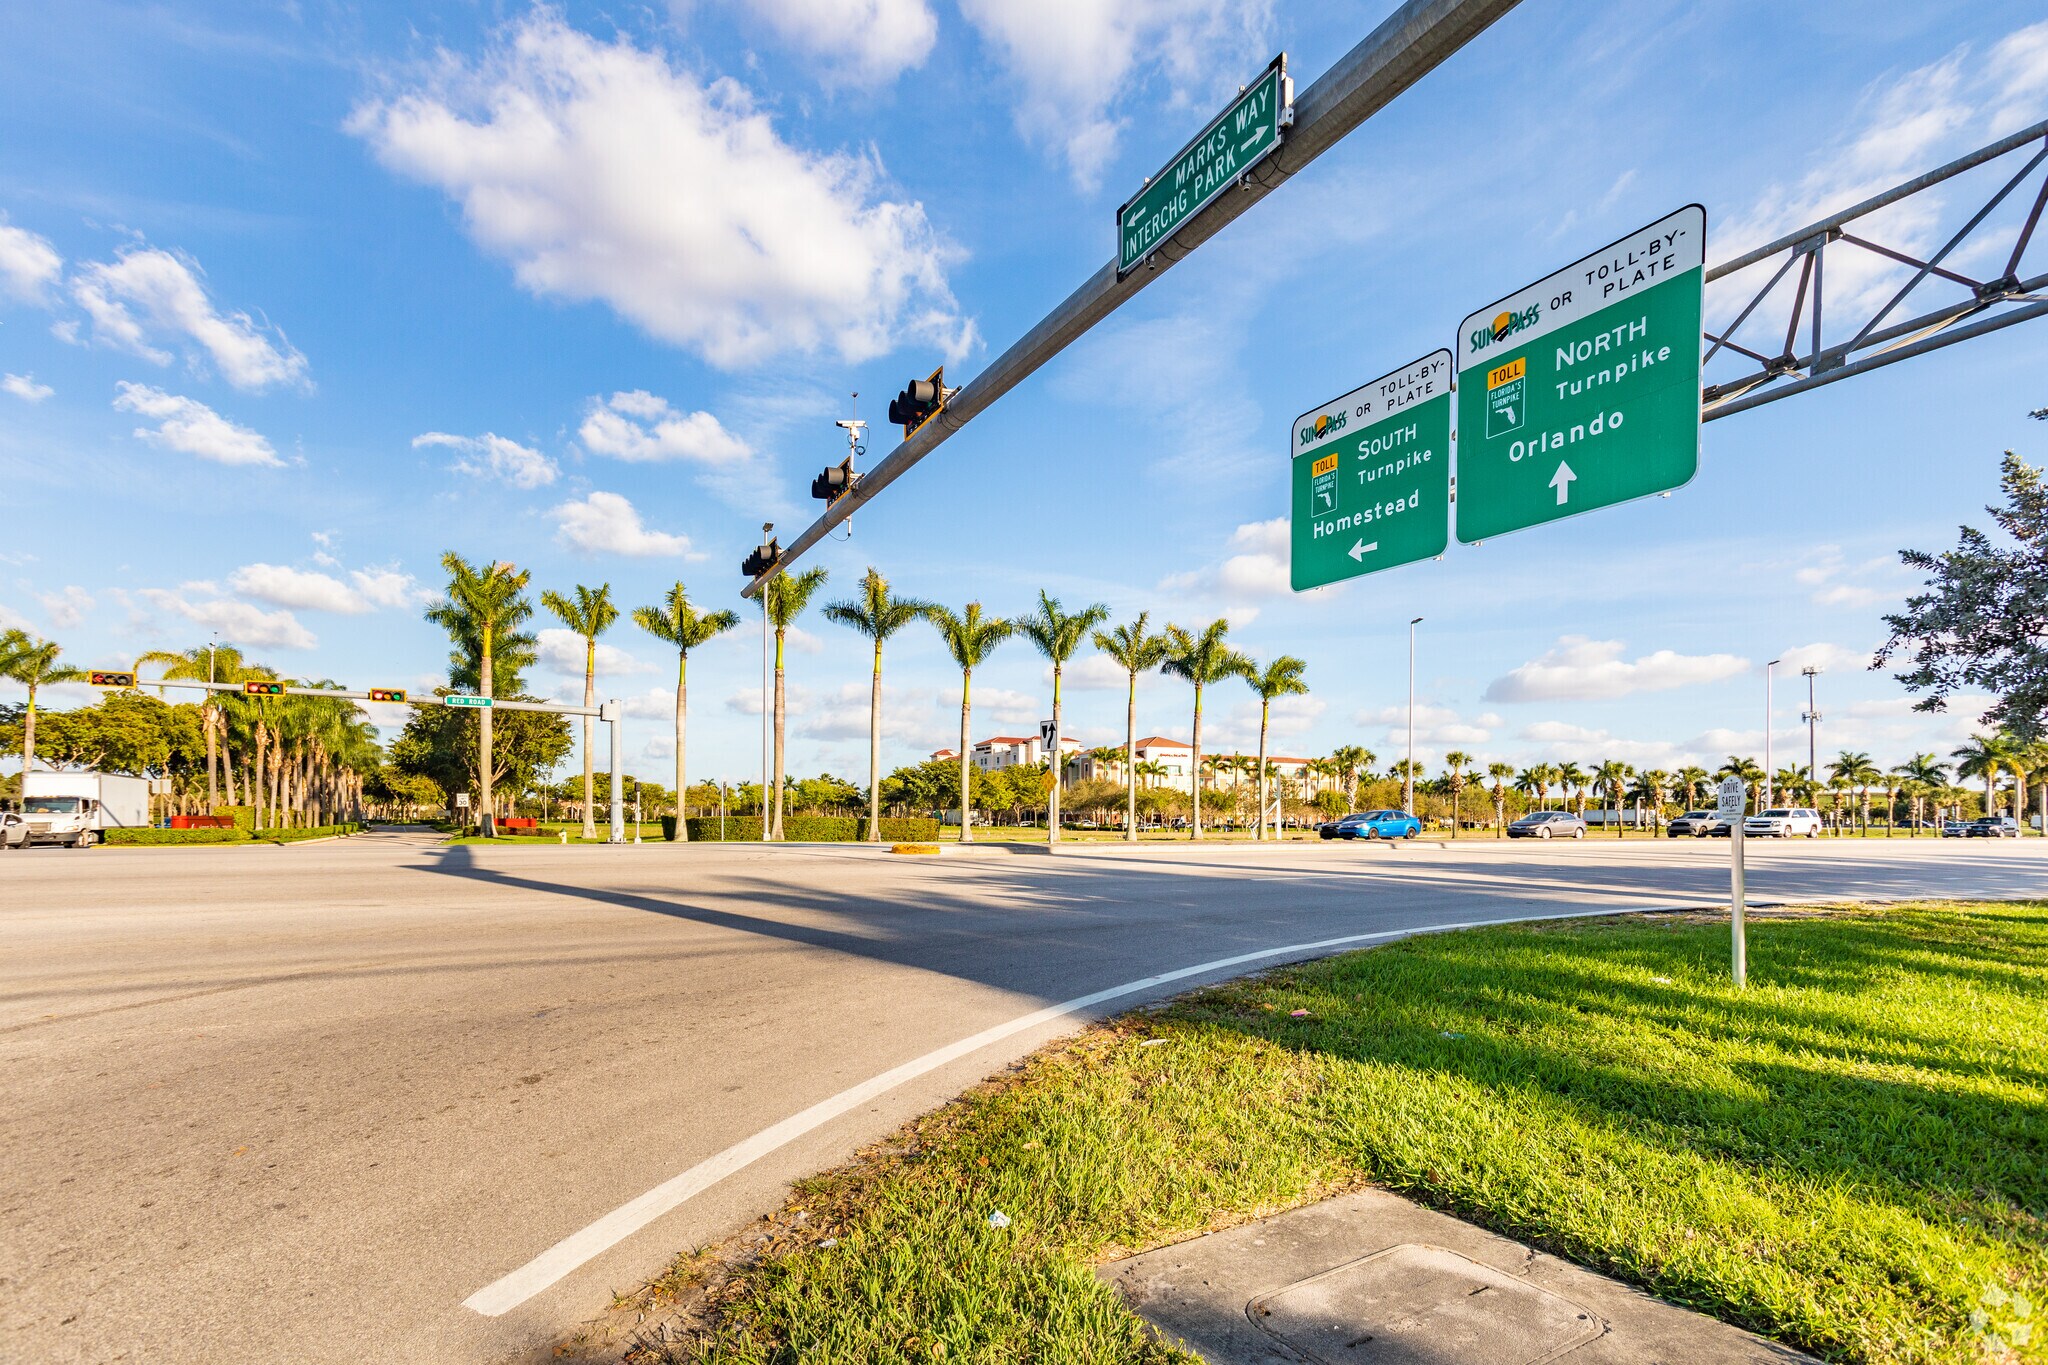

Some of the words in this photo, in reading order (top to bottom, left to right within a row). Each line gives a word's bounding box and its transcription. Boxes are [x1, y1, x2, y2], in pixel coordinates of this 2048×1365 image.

[1175, 126, 1226, 189] MARKS
[1235, 84, 1270, 135] WAY
[1126, 189, 1187, 261] INTERCHG
[1194, 144, 1236, 200] PARK
[1585, 229, 1686, 285] TOLL-BY-
[1603, 253, 1675, 298] PLATE
[1550, 291, 1572, 311] OR
[1556, 316, 1647, 371] NORTH
[1380, 360, 1445, 397] TOLL-BY-
[1490, 381, 1522, 400] FLORIDA'S
[1492, 363, 1521, 384] TOLL
[1556, 346, 1671, 400] Turnpike
[1356, 403, 1371, 417] OR
[1387, 381, 1433, 411] PLATE
[1492, 391, 1520, 409] TURNPIKE
[1357, 423, 1417, 461] SOUTH
[1509, 411, 1624, 462] Orlando
[1315, 457, 1335, 473] TOLL
[1358, 450, 1432, 484] Turnpike
[1313, 489, 1419, 539] Homestead
[1722, 796, 1741, 807] SAFELY
[1724, 782, 1738, 793] DRIVE
